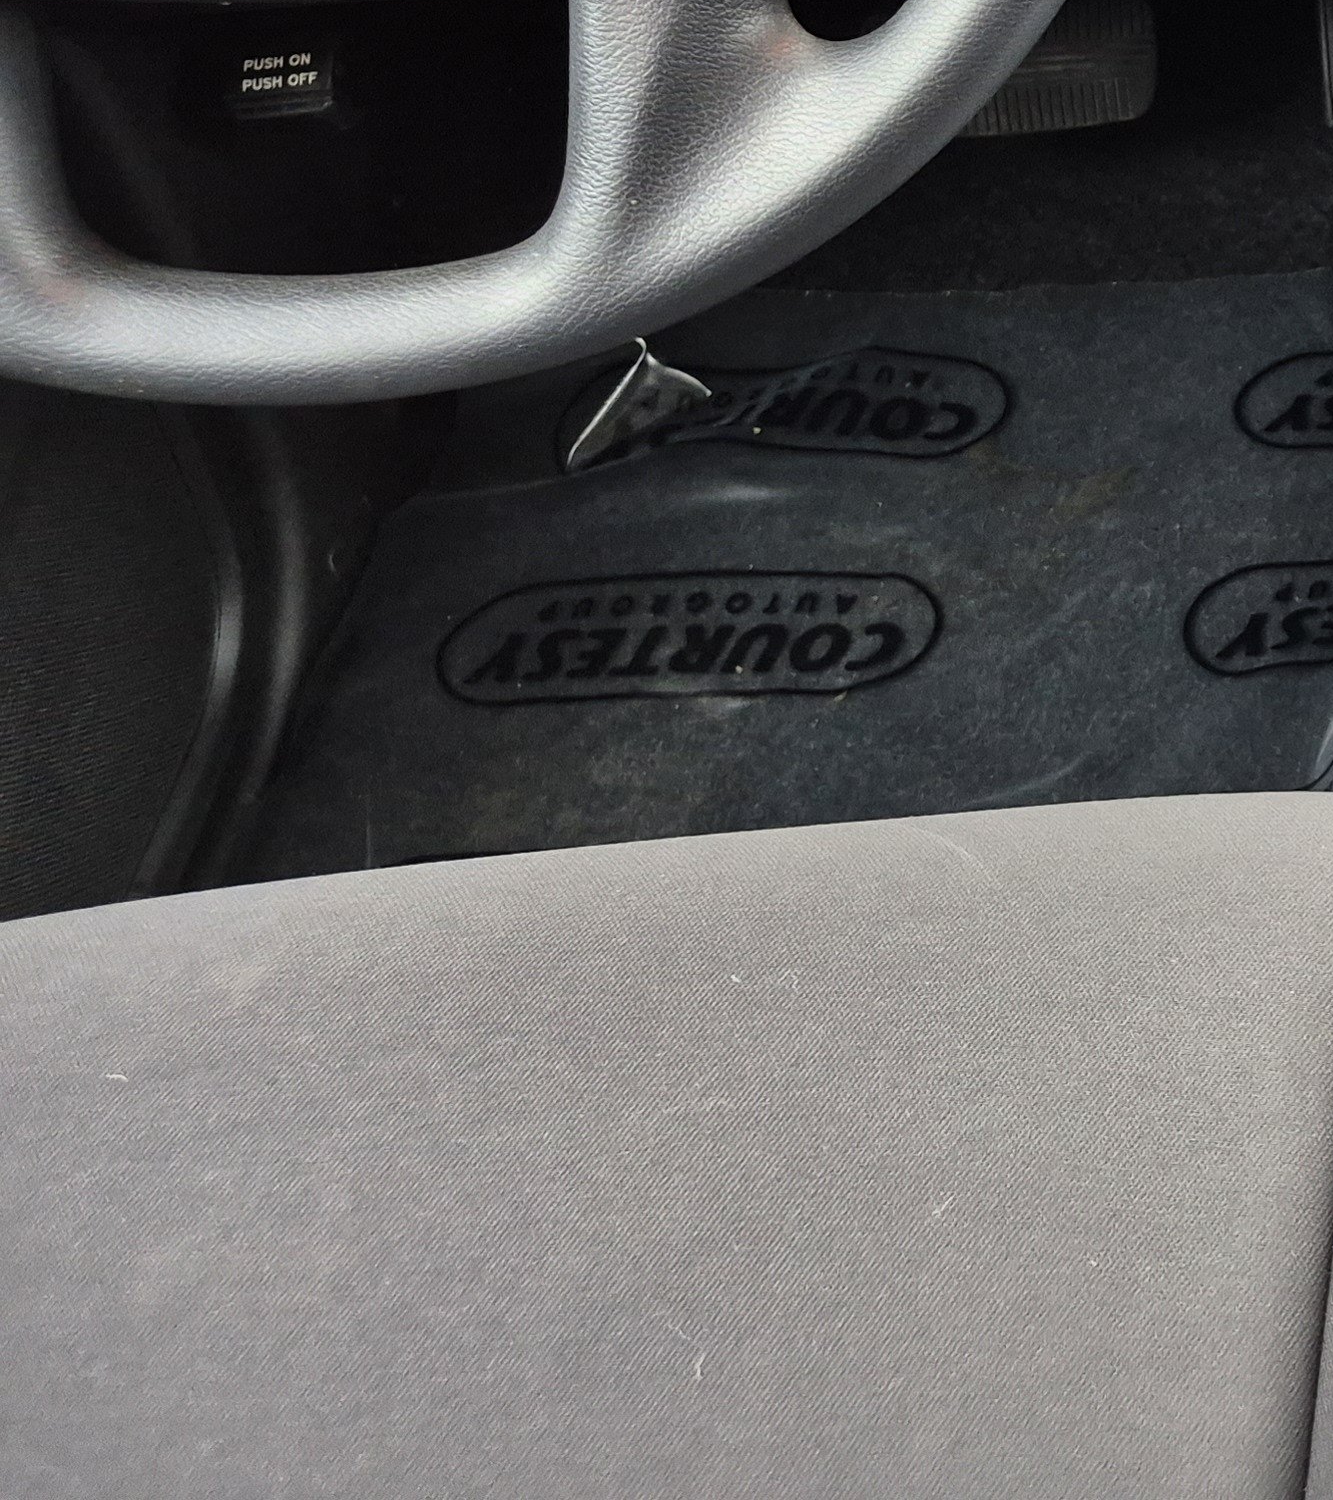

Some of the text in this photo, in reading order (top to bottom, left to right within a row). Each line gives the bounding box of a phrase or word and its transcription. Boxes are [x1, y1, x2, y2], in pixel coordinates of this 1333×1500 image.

[243, 53, 311, 72] PUSH ON
[242, 71, 318, 92] PUSH OFF
[537, 592, 861, 621] AUTOGROUP
[462, 622, 906, 684] COURTESY
